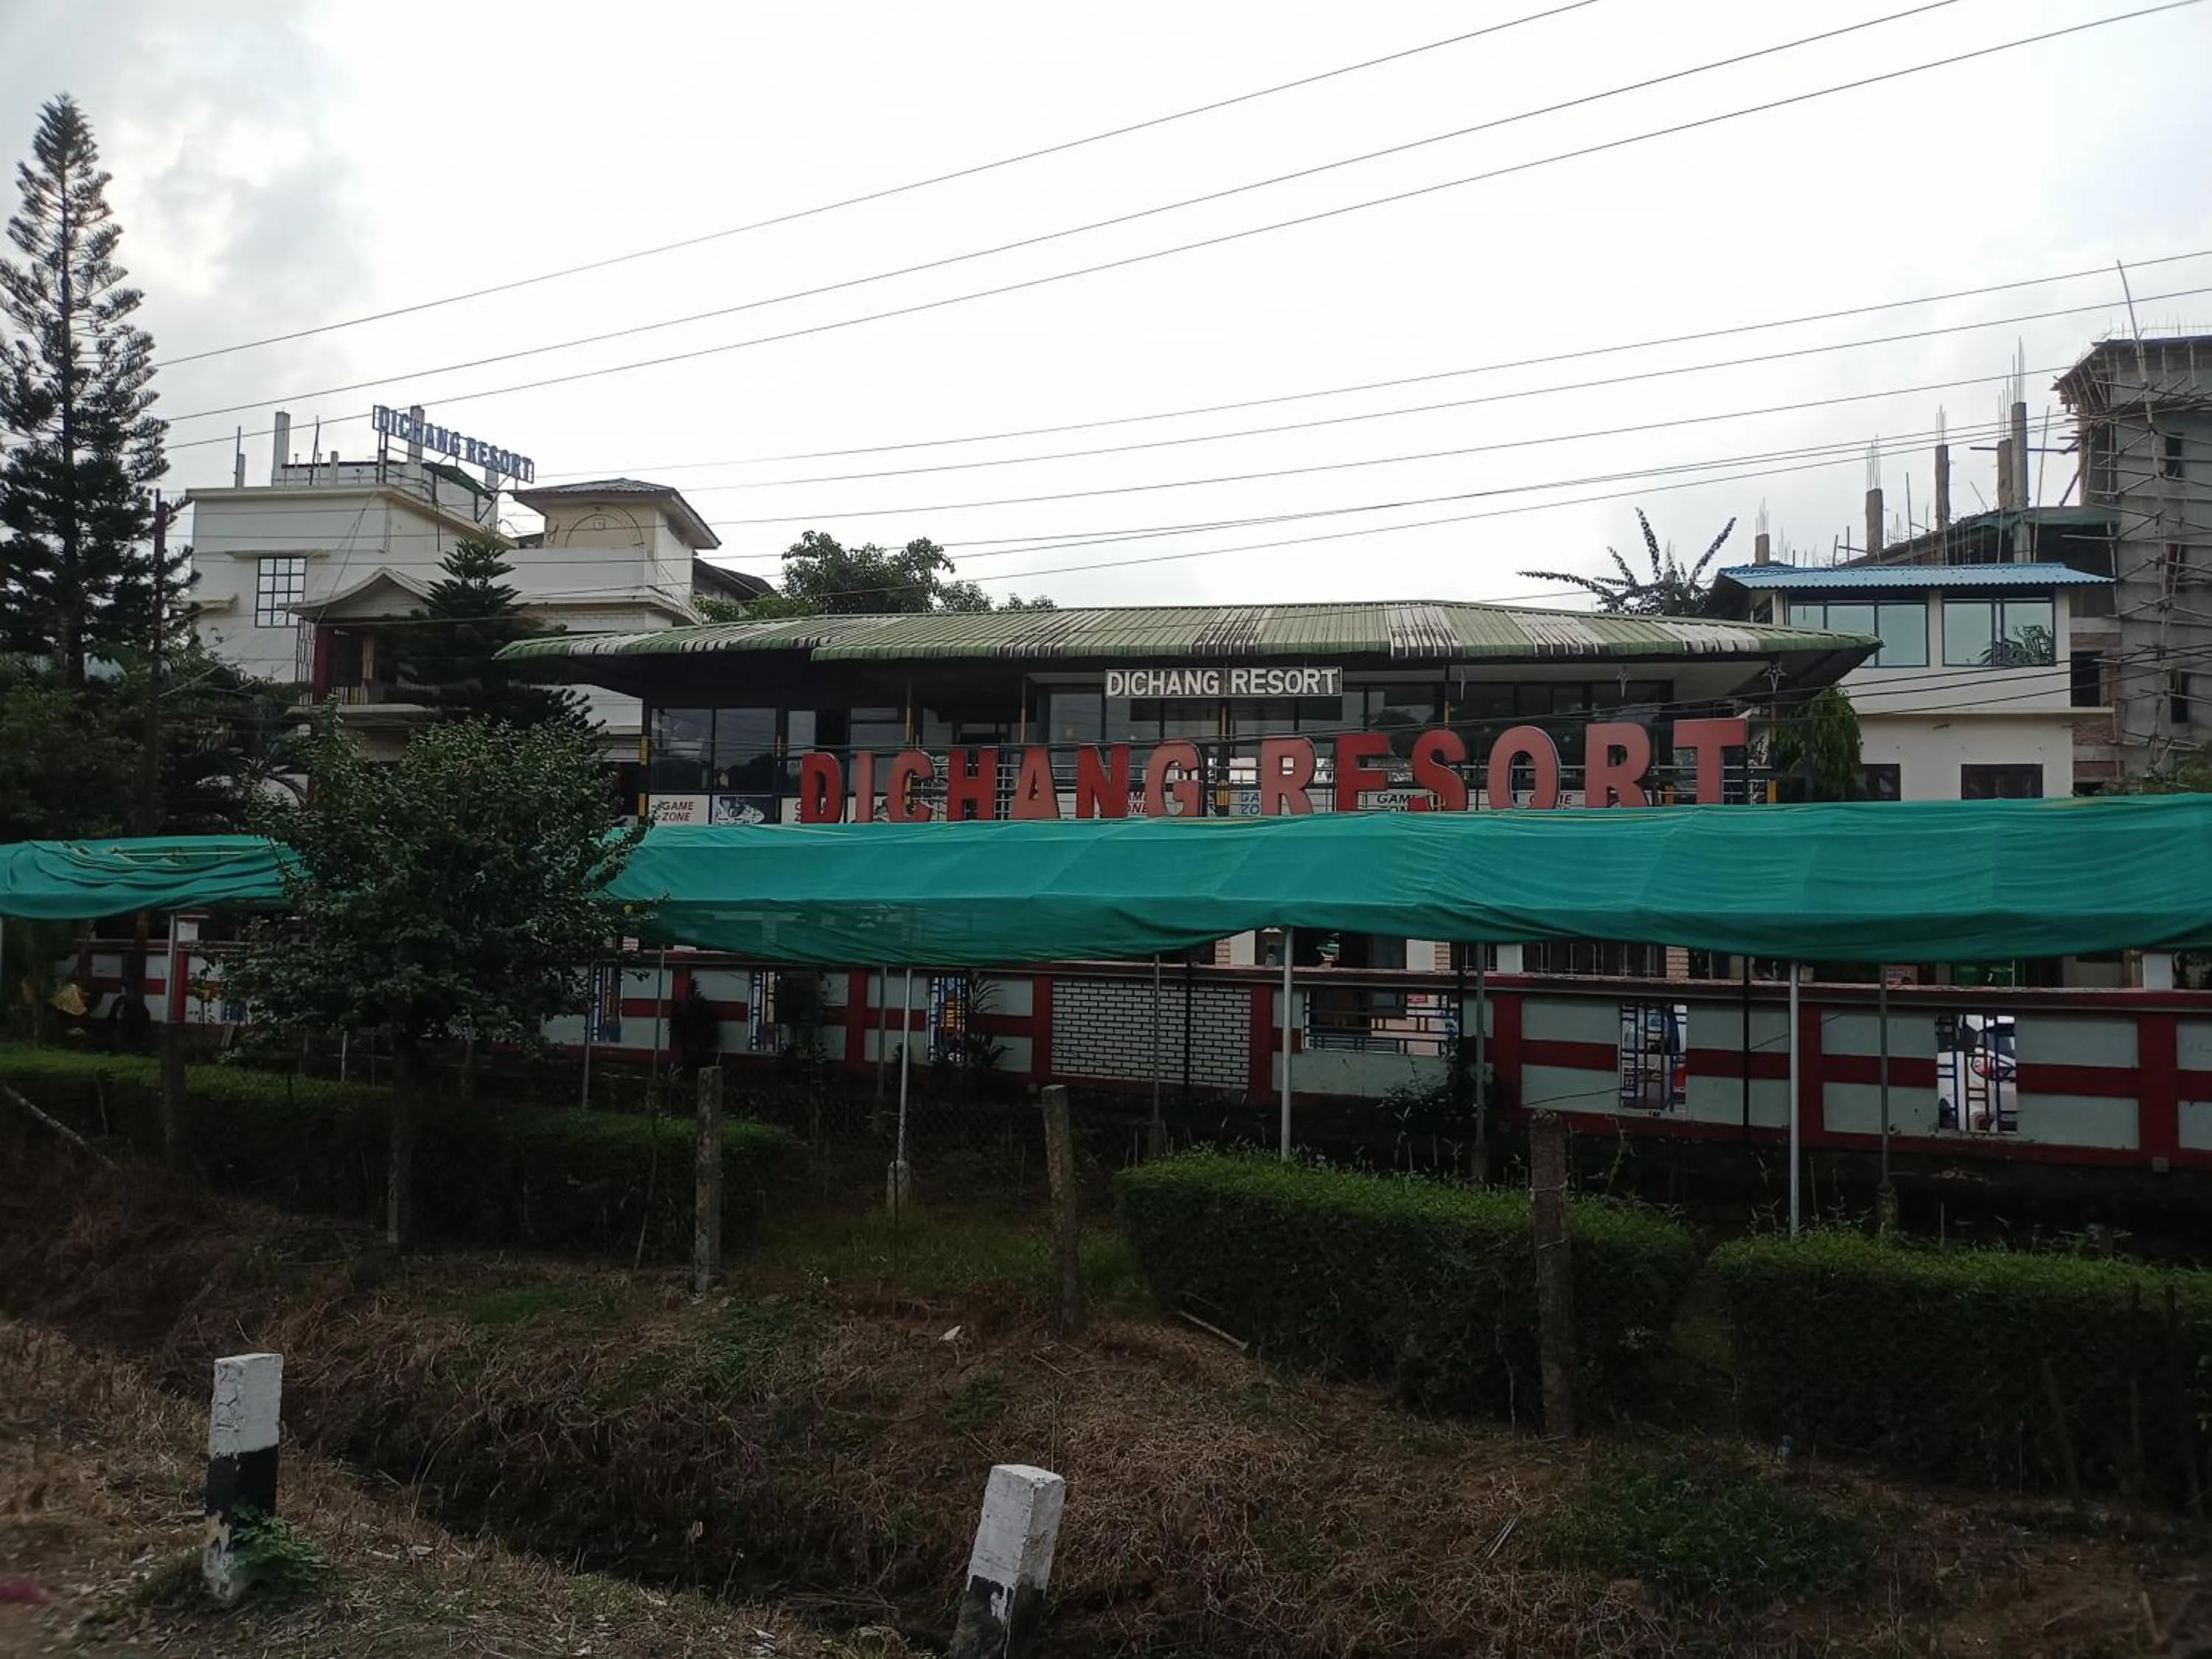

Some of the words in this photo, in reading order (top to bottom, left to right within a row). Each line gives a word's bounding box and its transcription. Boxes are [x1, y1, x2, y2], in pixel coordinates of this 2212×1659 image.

[378, 406, 461, 456] DICHANG
[466, 437, 532, 479] RESORT
[1107, 669, 1219, 695] DICHANG
[1231, 669, 1338, 695] RESORT
[801, 739, 1203, 824] DICHANG
[1260, 718, 1747, 815] RESORT
[661, 813, 691, 821] ZONE
[662, 801, 695, 810] GAME
